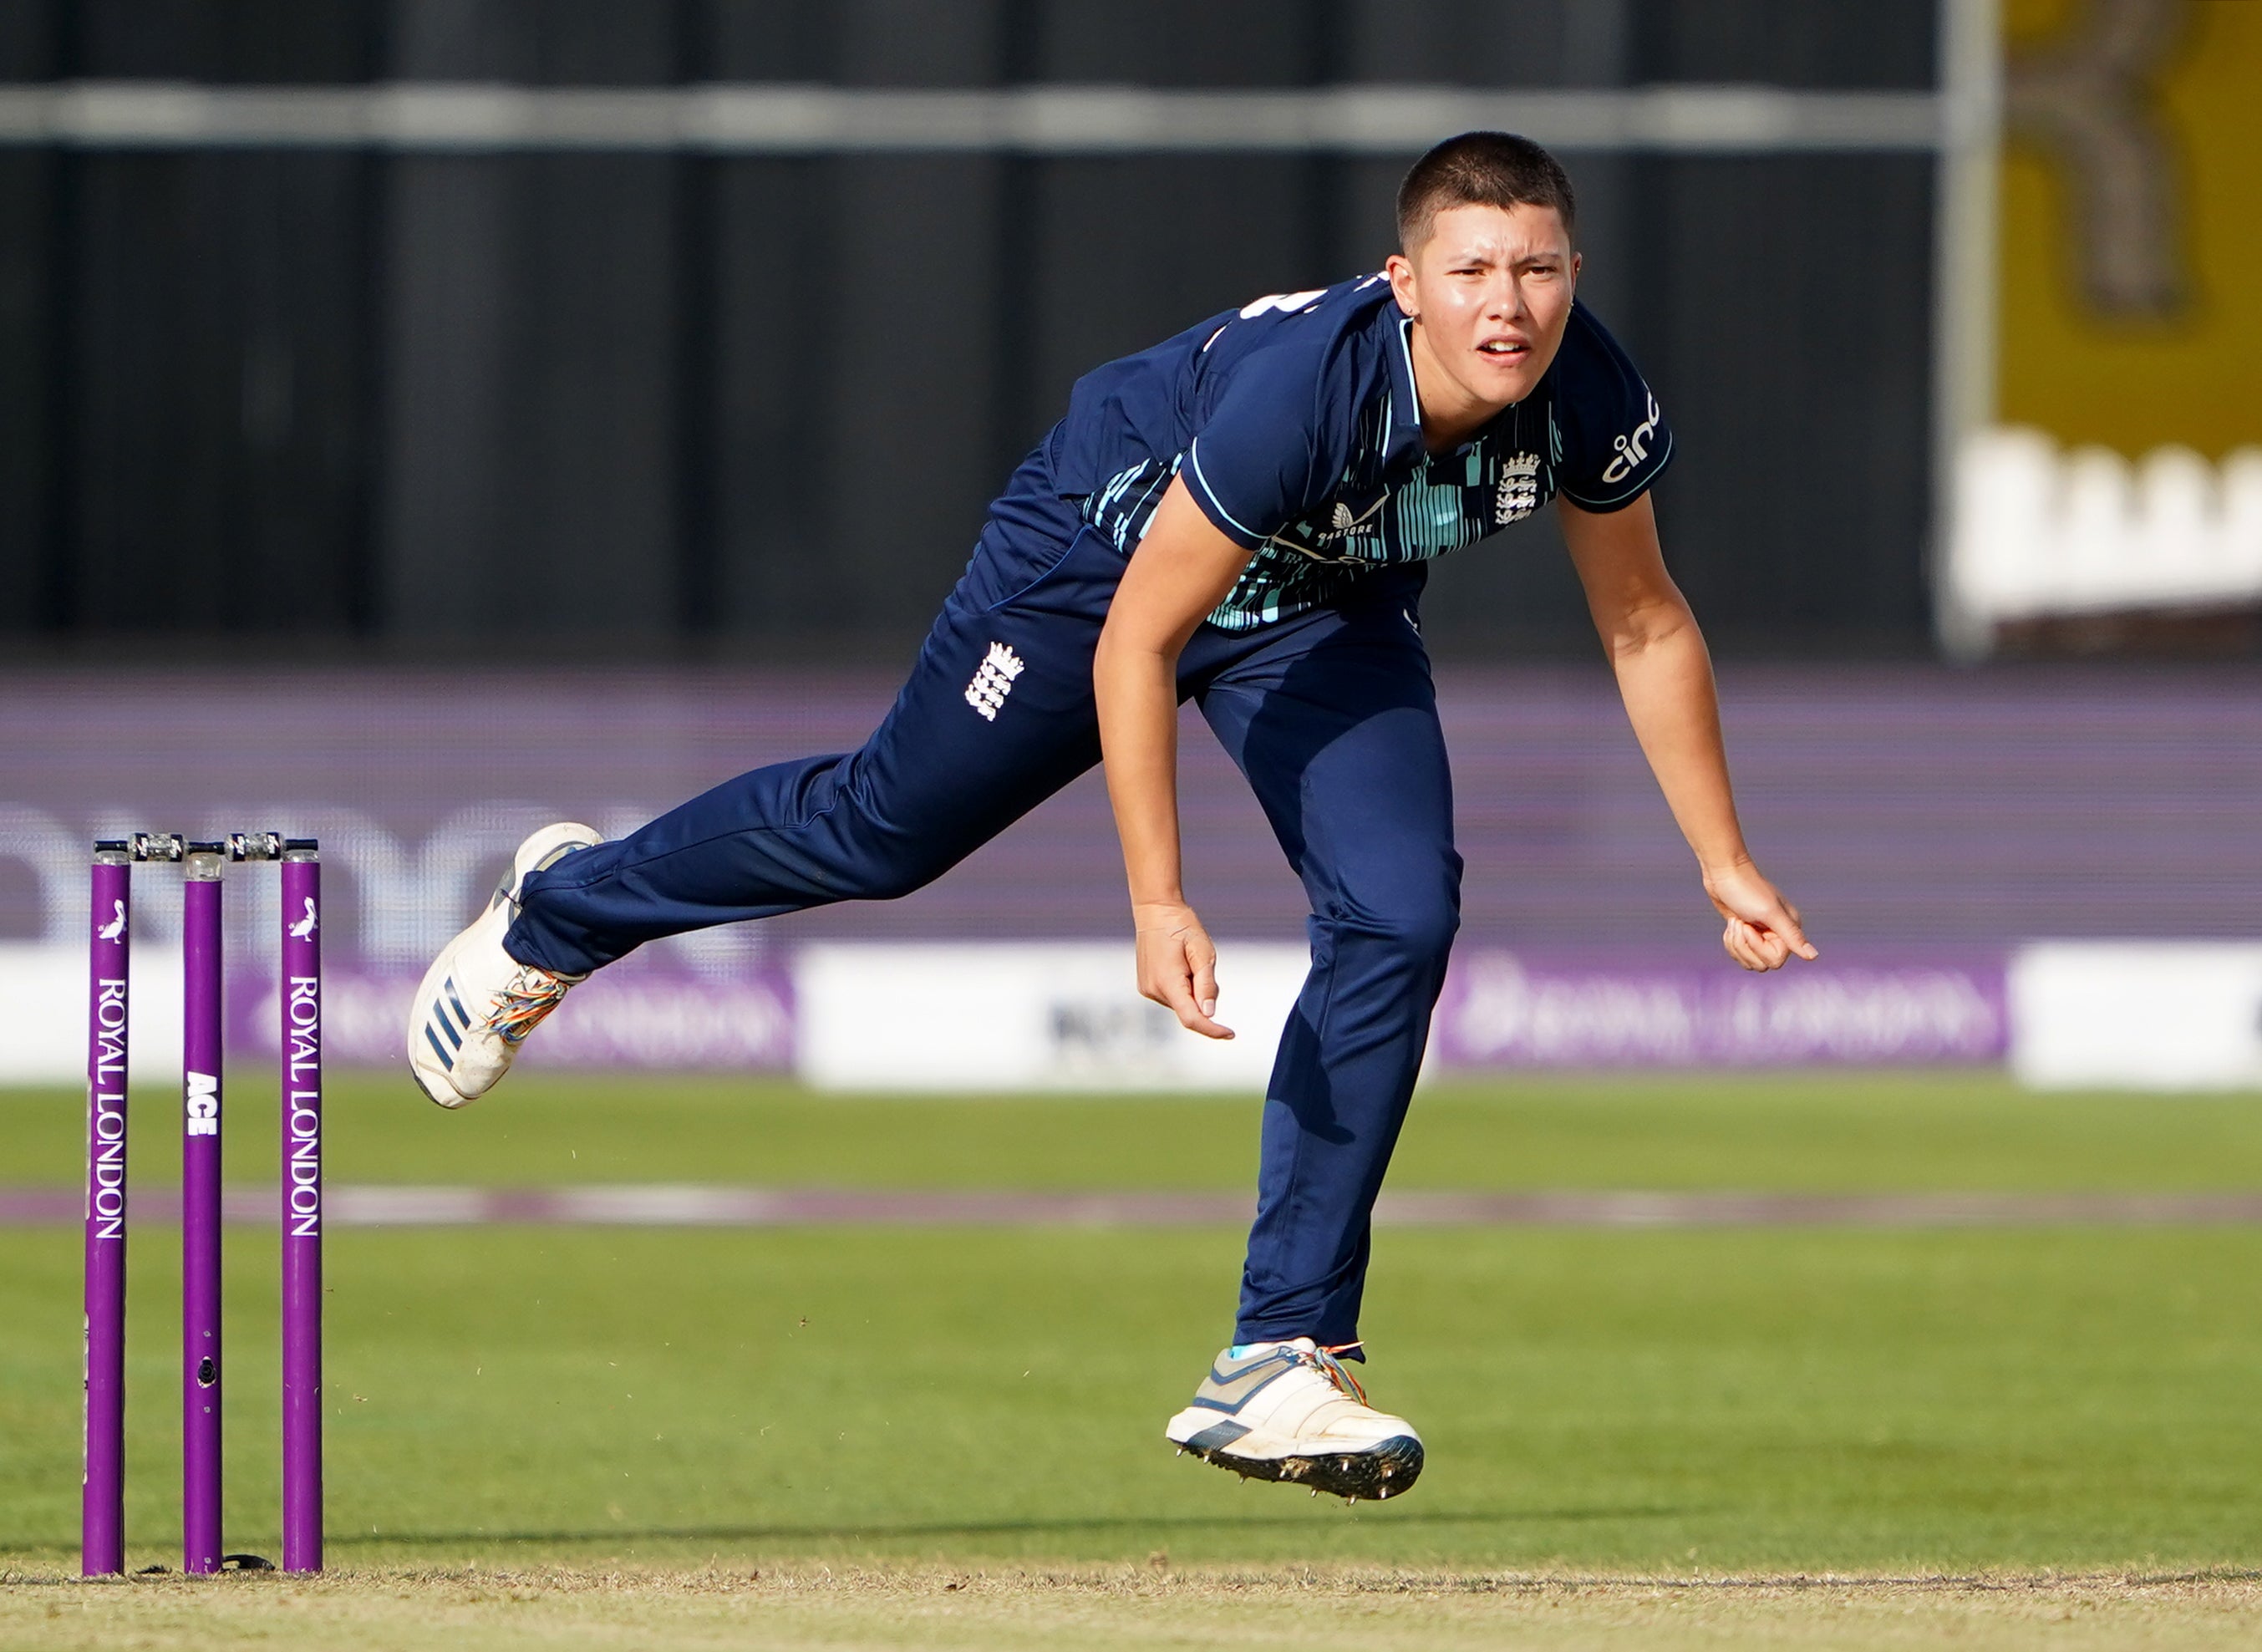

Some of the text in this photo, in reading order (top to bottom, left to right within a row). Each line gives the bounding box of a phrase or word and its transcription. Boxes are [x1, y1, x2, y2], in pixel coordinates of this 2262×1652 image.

[95, 978, 125, 1239] ROYAL LONDON
[187, 1070, 218, 1136] ACE
[290, 976, 318, 1237] ROYAL LONDON
